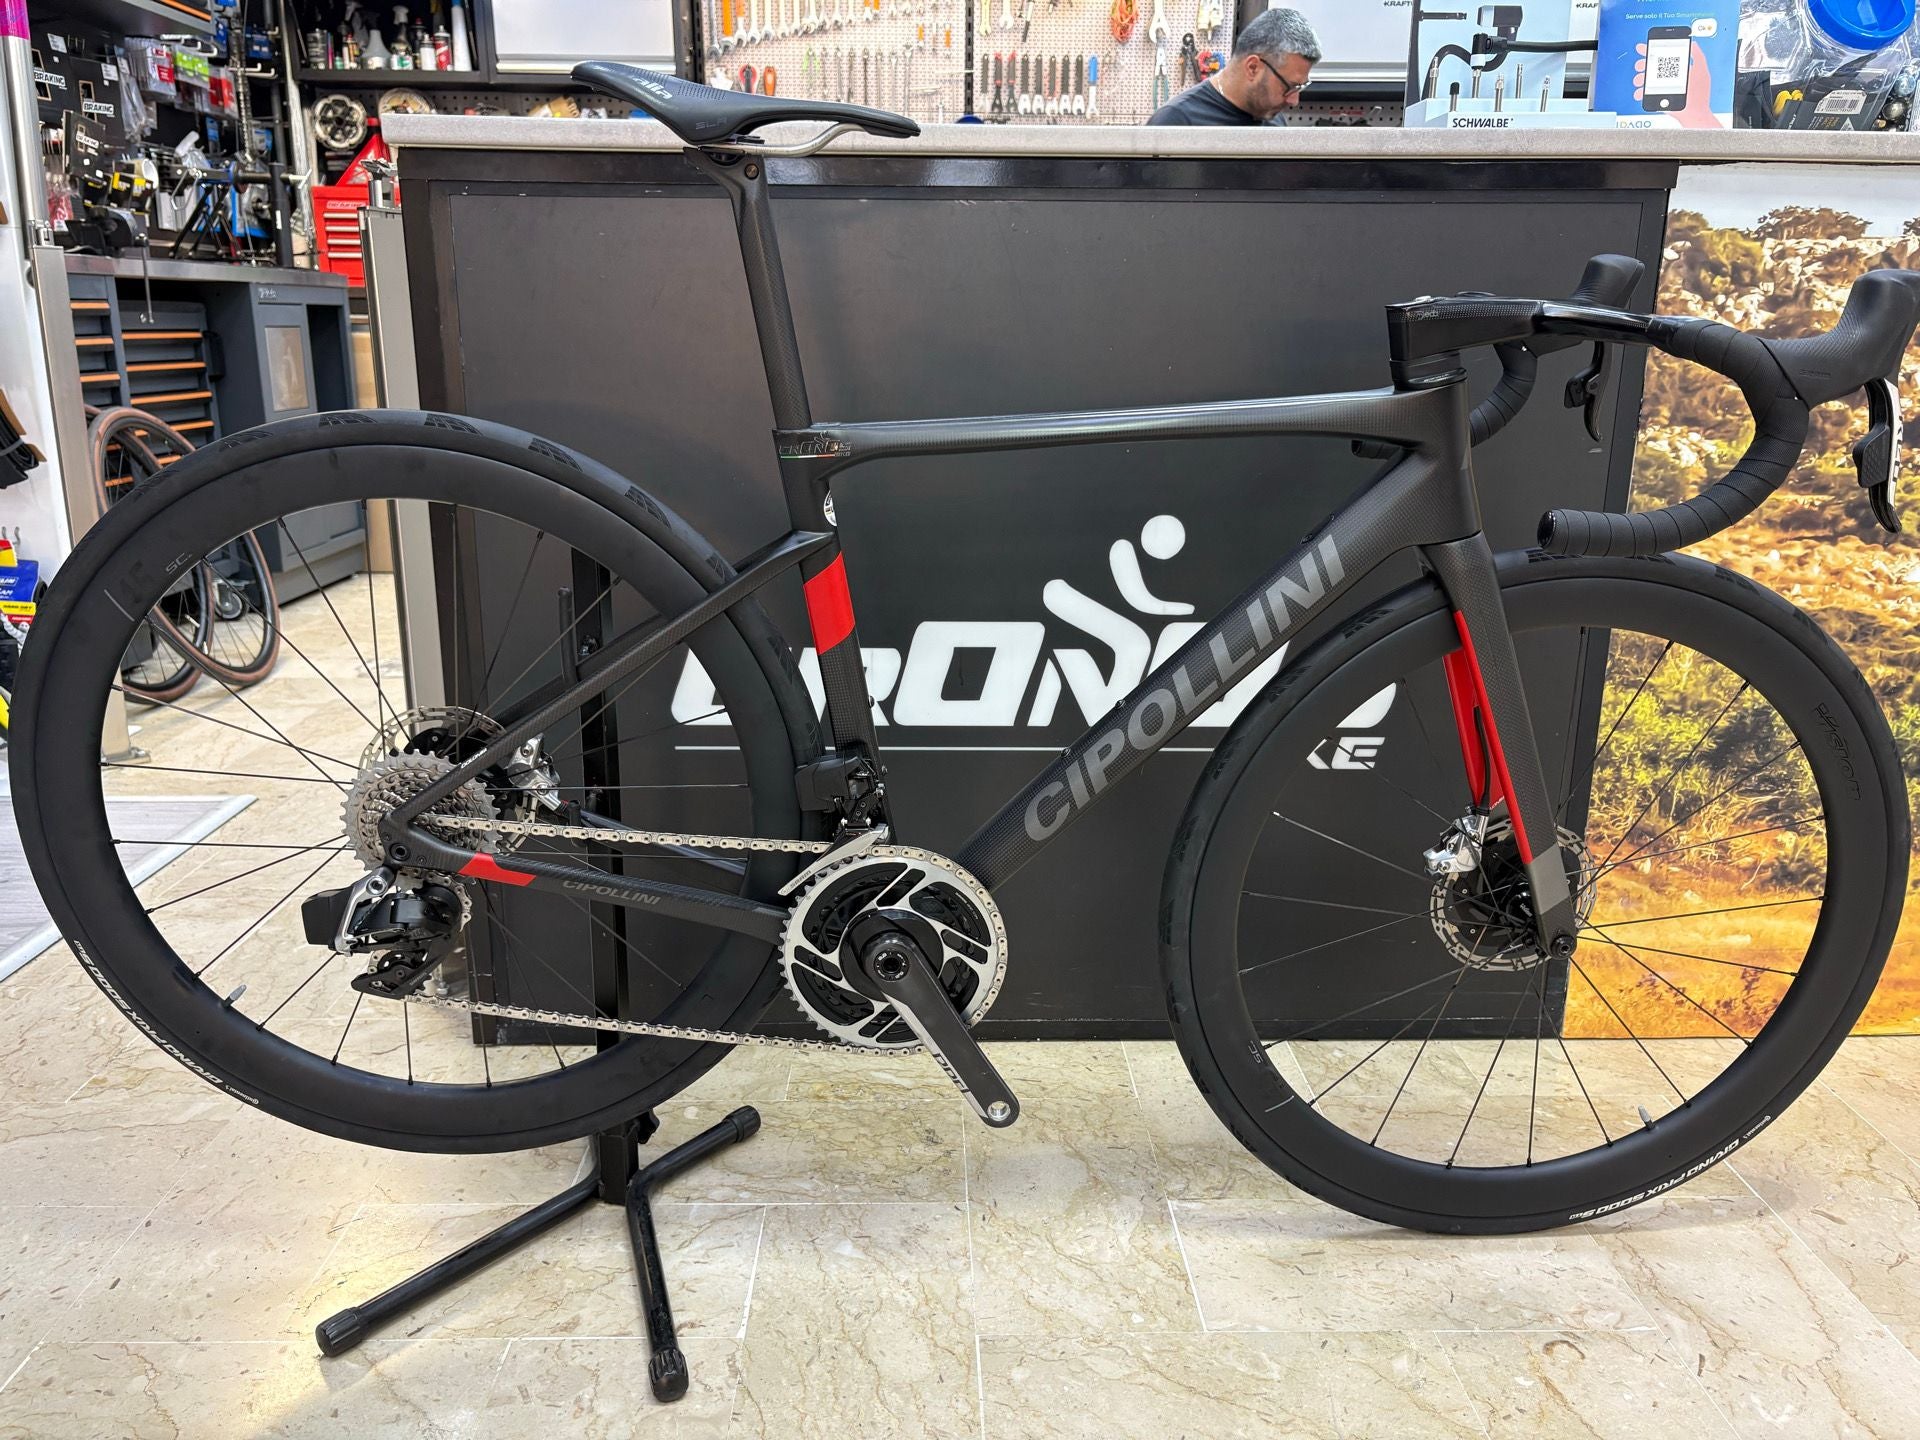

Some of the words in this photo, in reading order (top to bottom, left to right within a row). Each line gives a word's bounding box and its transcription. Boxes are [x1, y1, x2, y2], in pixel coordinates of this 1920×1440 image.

[84, 102, 114, 114] BRAKING
[1452, 118, 1509, 128] SCHWALBE
[1024, 534, 1347, 842] CIPOLLINI
[563, 880, 662, 905] CIPOLLINI
[89, 966, 132, 1011] 5000
[126, 1011, 167, 1045] PRIX
[163, 1044, 224, 1084] GRAND
[1686, 1138, 1741, 1177] GRAND
[1645, 1172, 1686, 1198] PRIX
[1595, 1191, 1646, 1216] 5000
